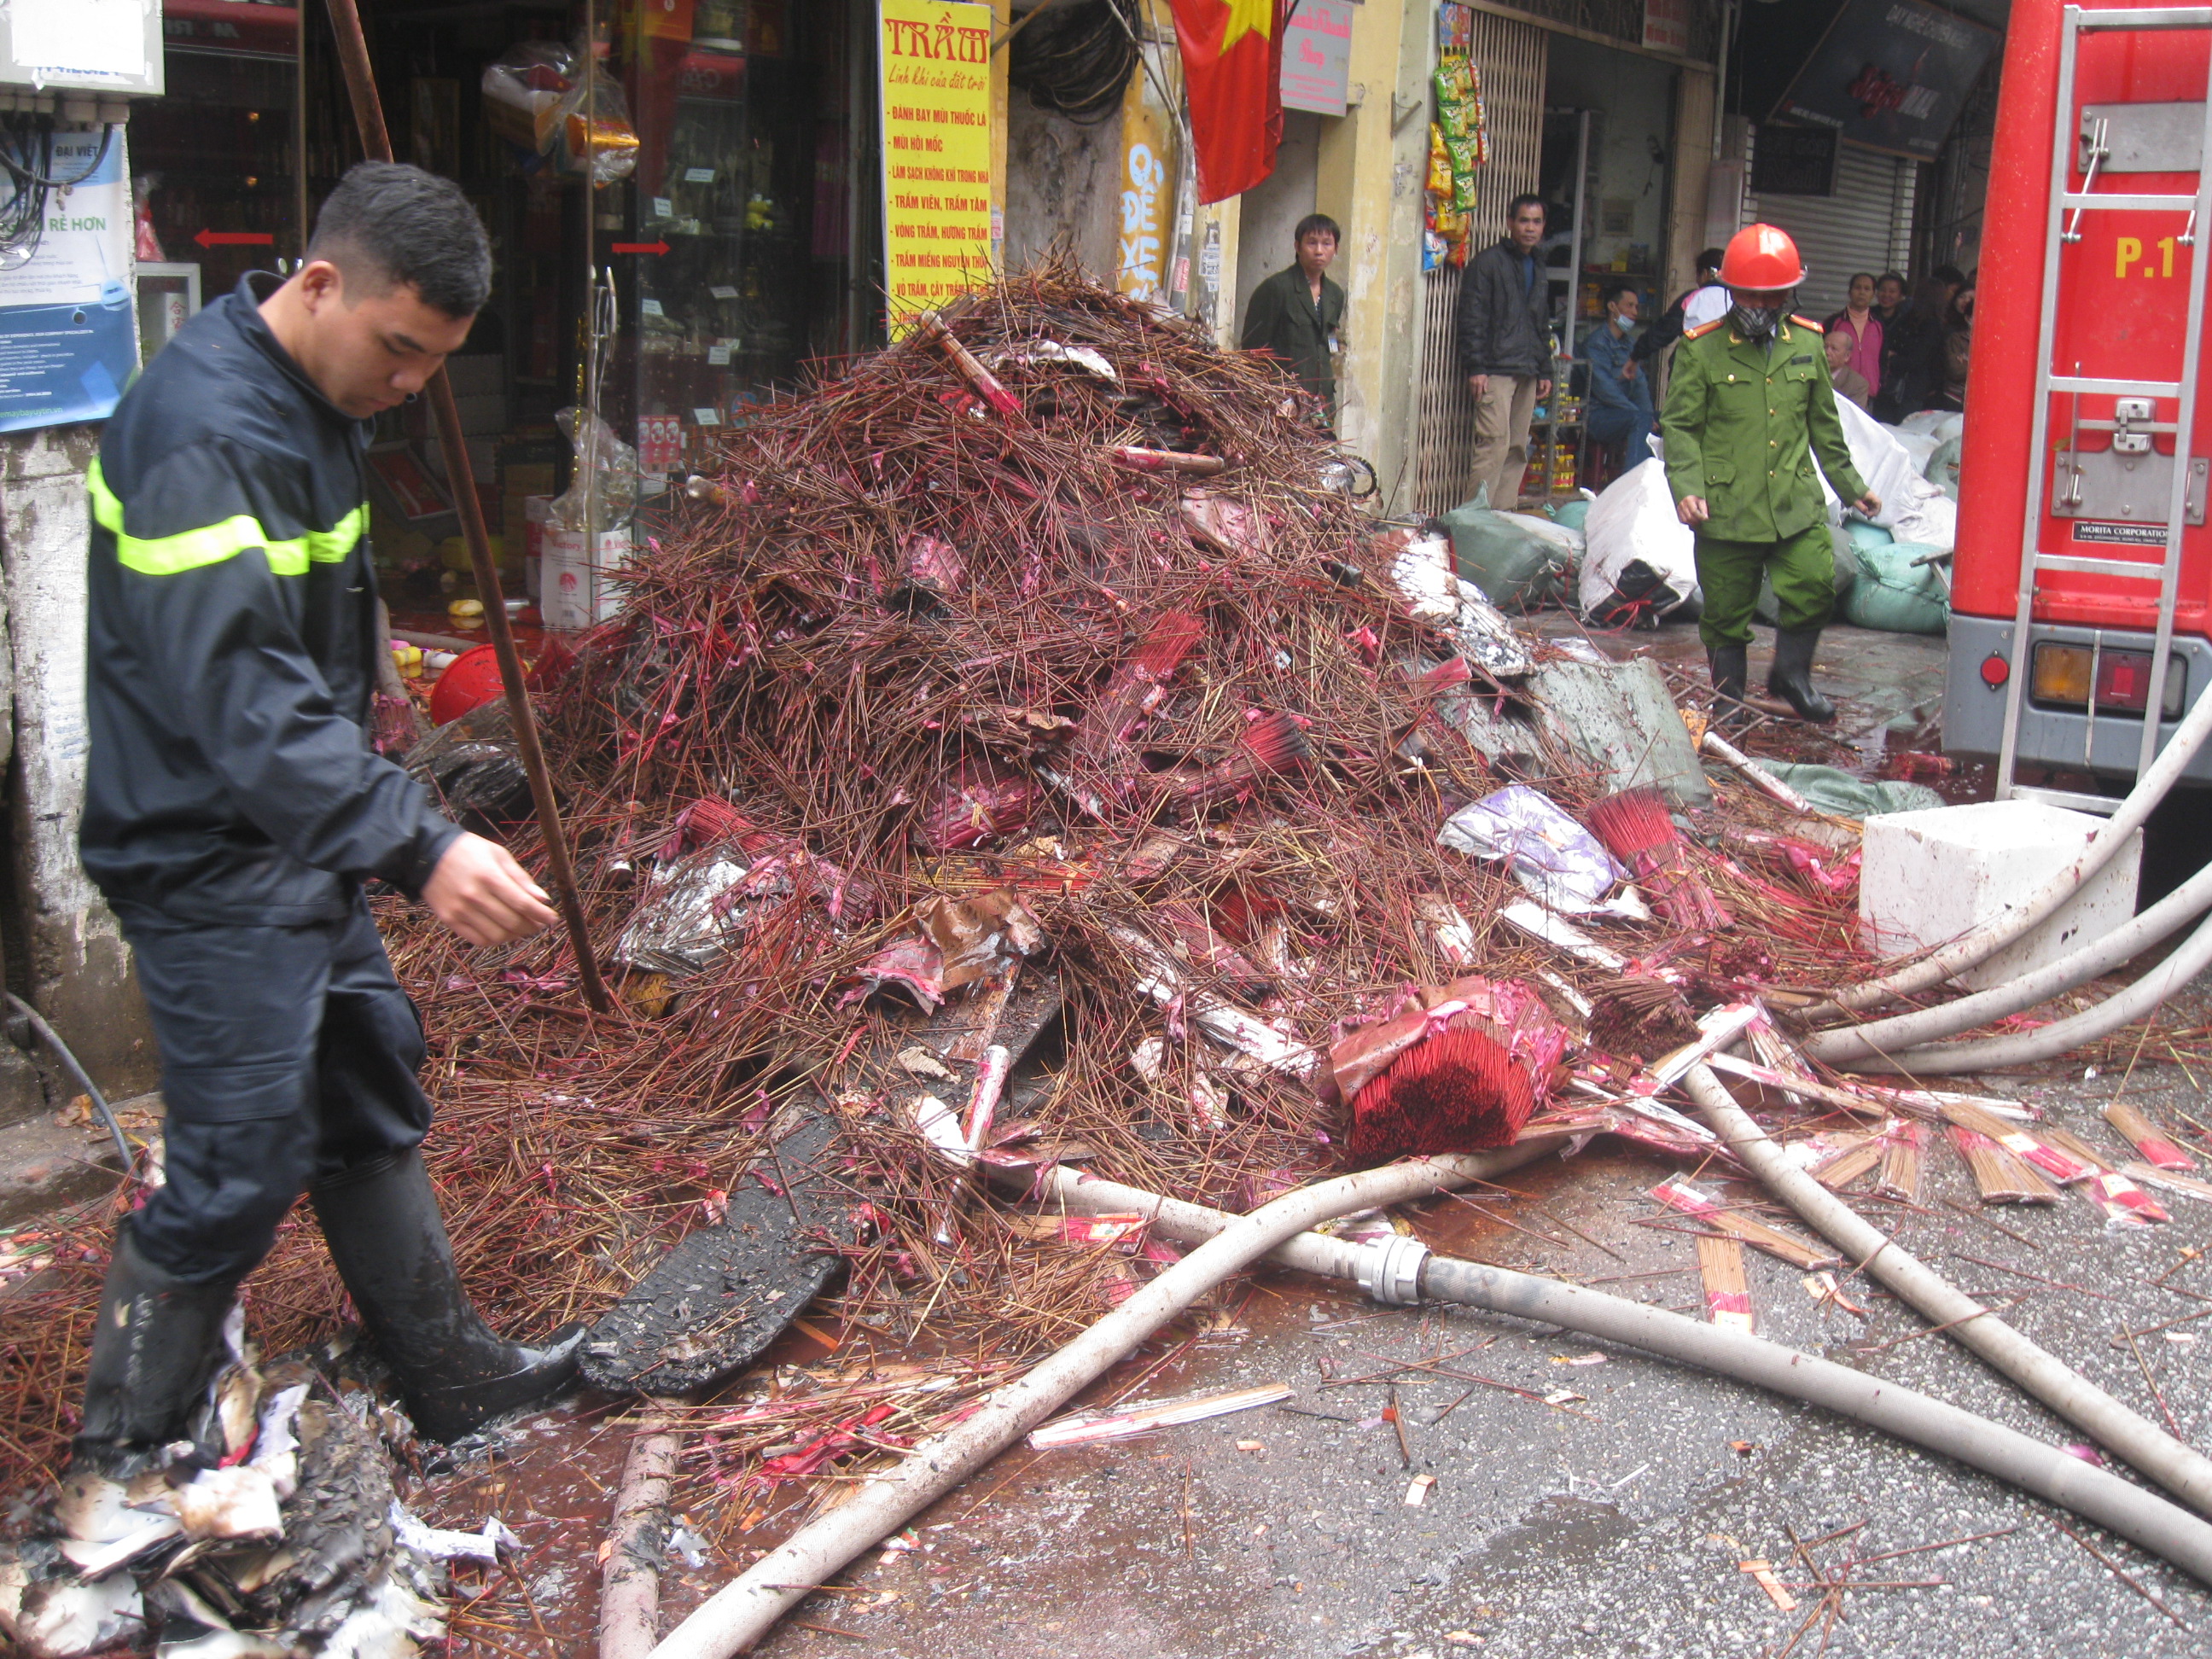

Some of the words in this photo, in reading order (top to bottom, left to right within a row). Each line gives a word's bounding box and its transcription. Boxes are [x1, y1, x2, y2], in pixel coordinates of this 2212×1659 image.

[884, 11, 990, 64] TRẦM
[888, 63, 910, 84] Linh
[916, 108, 931, 122] BAY
[958, 169, 976, 183] TRONG
[71, 216, 107, 231] HƠN
[1121, 236, 1161, 282] XE
[2116, 236, 2174, 278] P.1
[2080, 525, 2110, 534] MORITA
